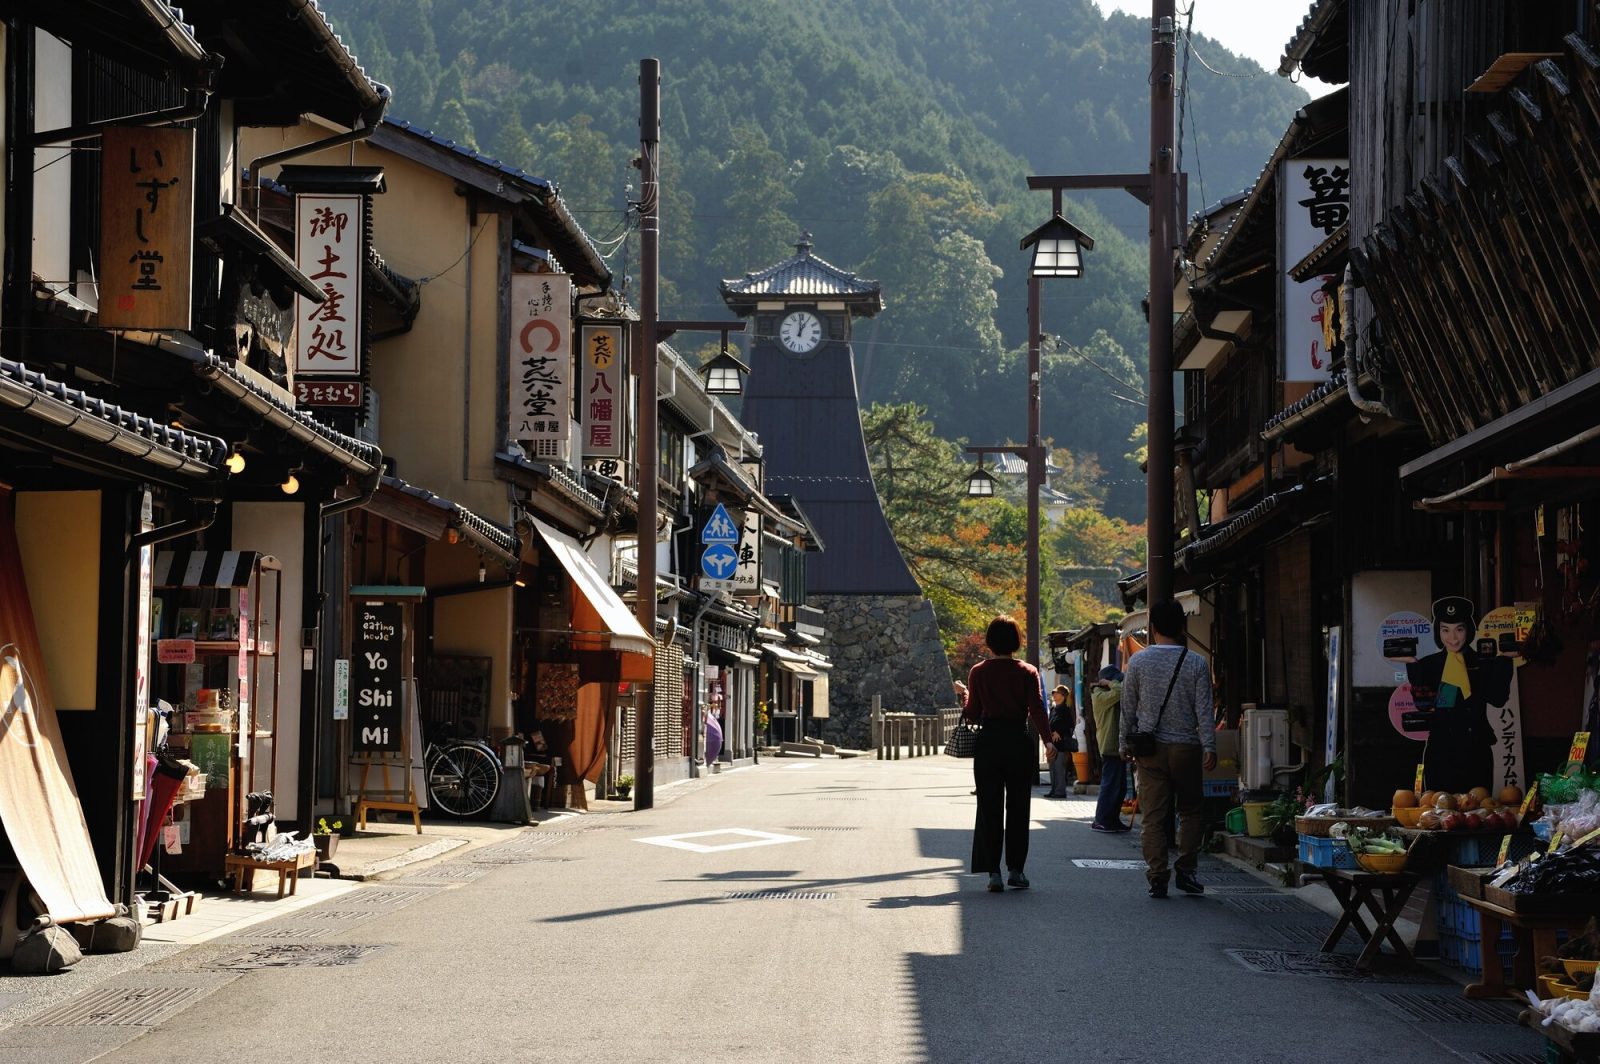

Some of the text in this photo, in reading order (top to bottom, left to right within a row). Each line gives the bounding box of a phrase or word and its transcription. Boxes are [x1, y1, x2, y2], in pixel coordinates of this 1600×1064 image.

[130, 146, 179, 291] いずし堂
[308, 206, 349, 361] 御土産処
[298, 383, 356, 403] きたむら
[590, 372, 613, 447] 八幡屋
[520, 420, 560, 433] 八幡屋
[363, 612, 376, 621] an
[363, 621, 394, 635] eating
[363, 631, 390, 641] house
[1414, 624, 1431, 634] 105
[364, 651, 388, 671] Yo
[358, 688, 393, 707] Shi
[361, 726, 389, 745] Mi
